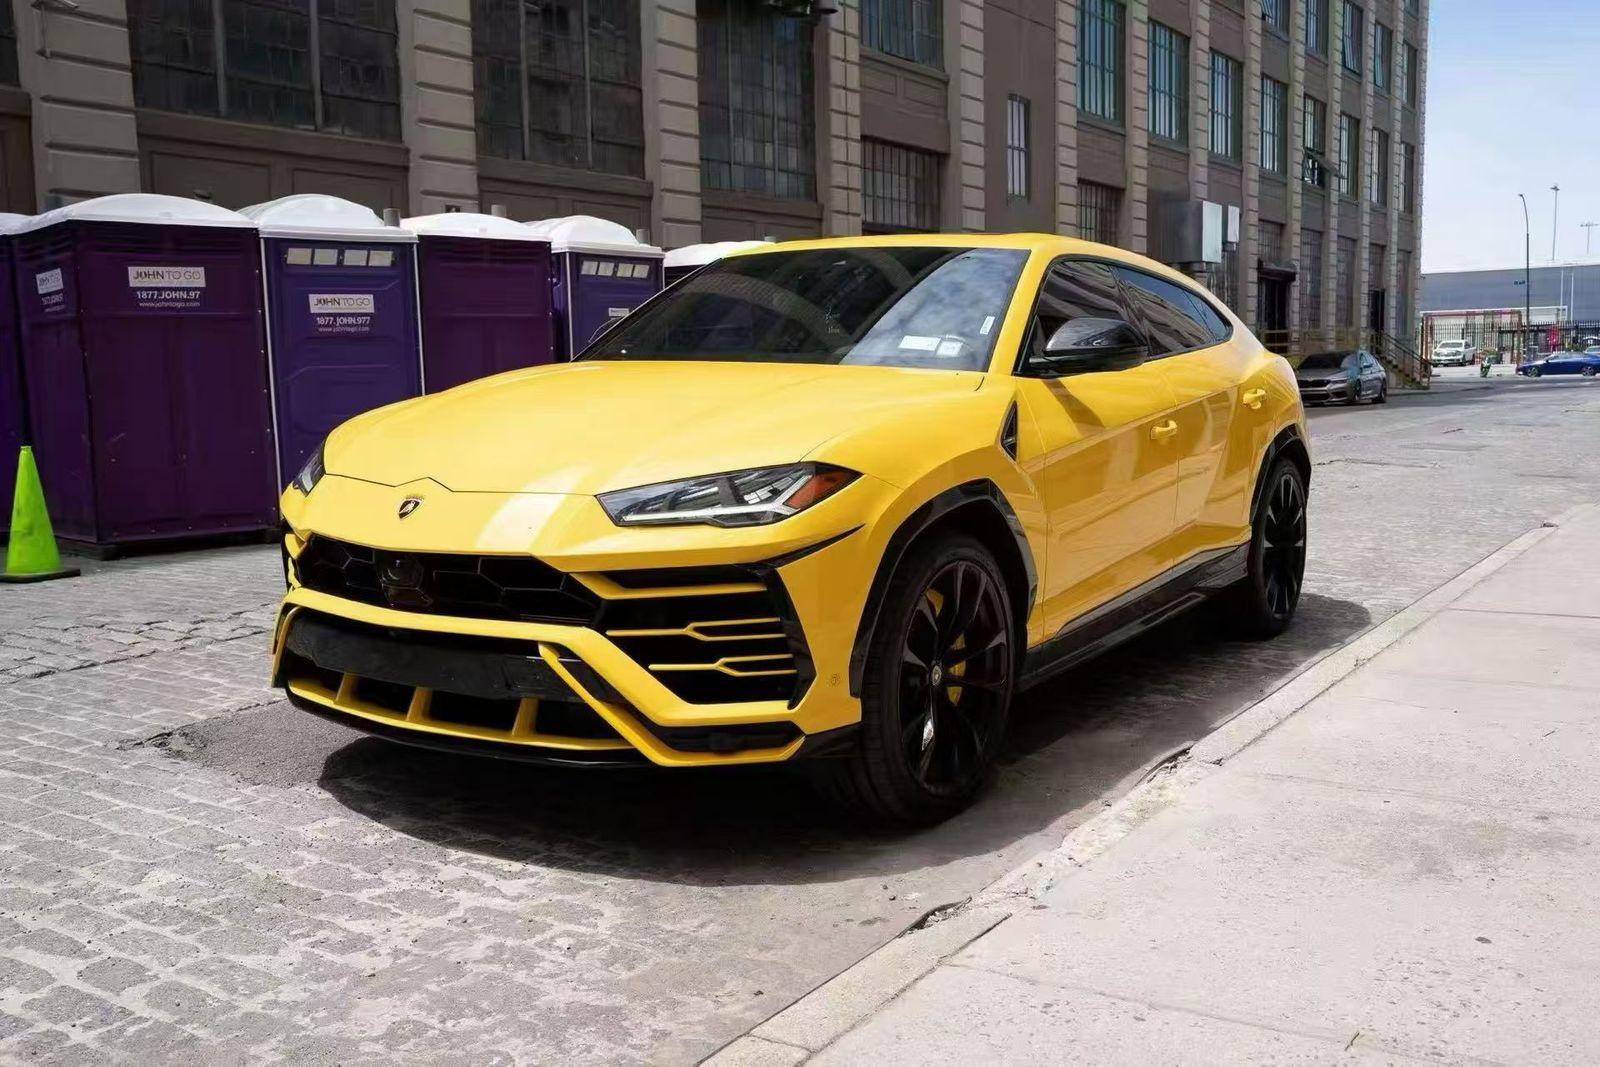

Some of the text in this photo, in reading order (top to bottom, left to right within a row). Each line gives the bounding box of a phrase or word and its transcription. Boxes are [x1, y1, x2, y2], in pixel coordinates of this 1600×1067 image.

[133, 270, 201, 280] JOHN TO GO
[314, 297, 371, 306] JOHN TO GO
